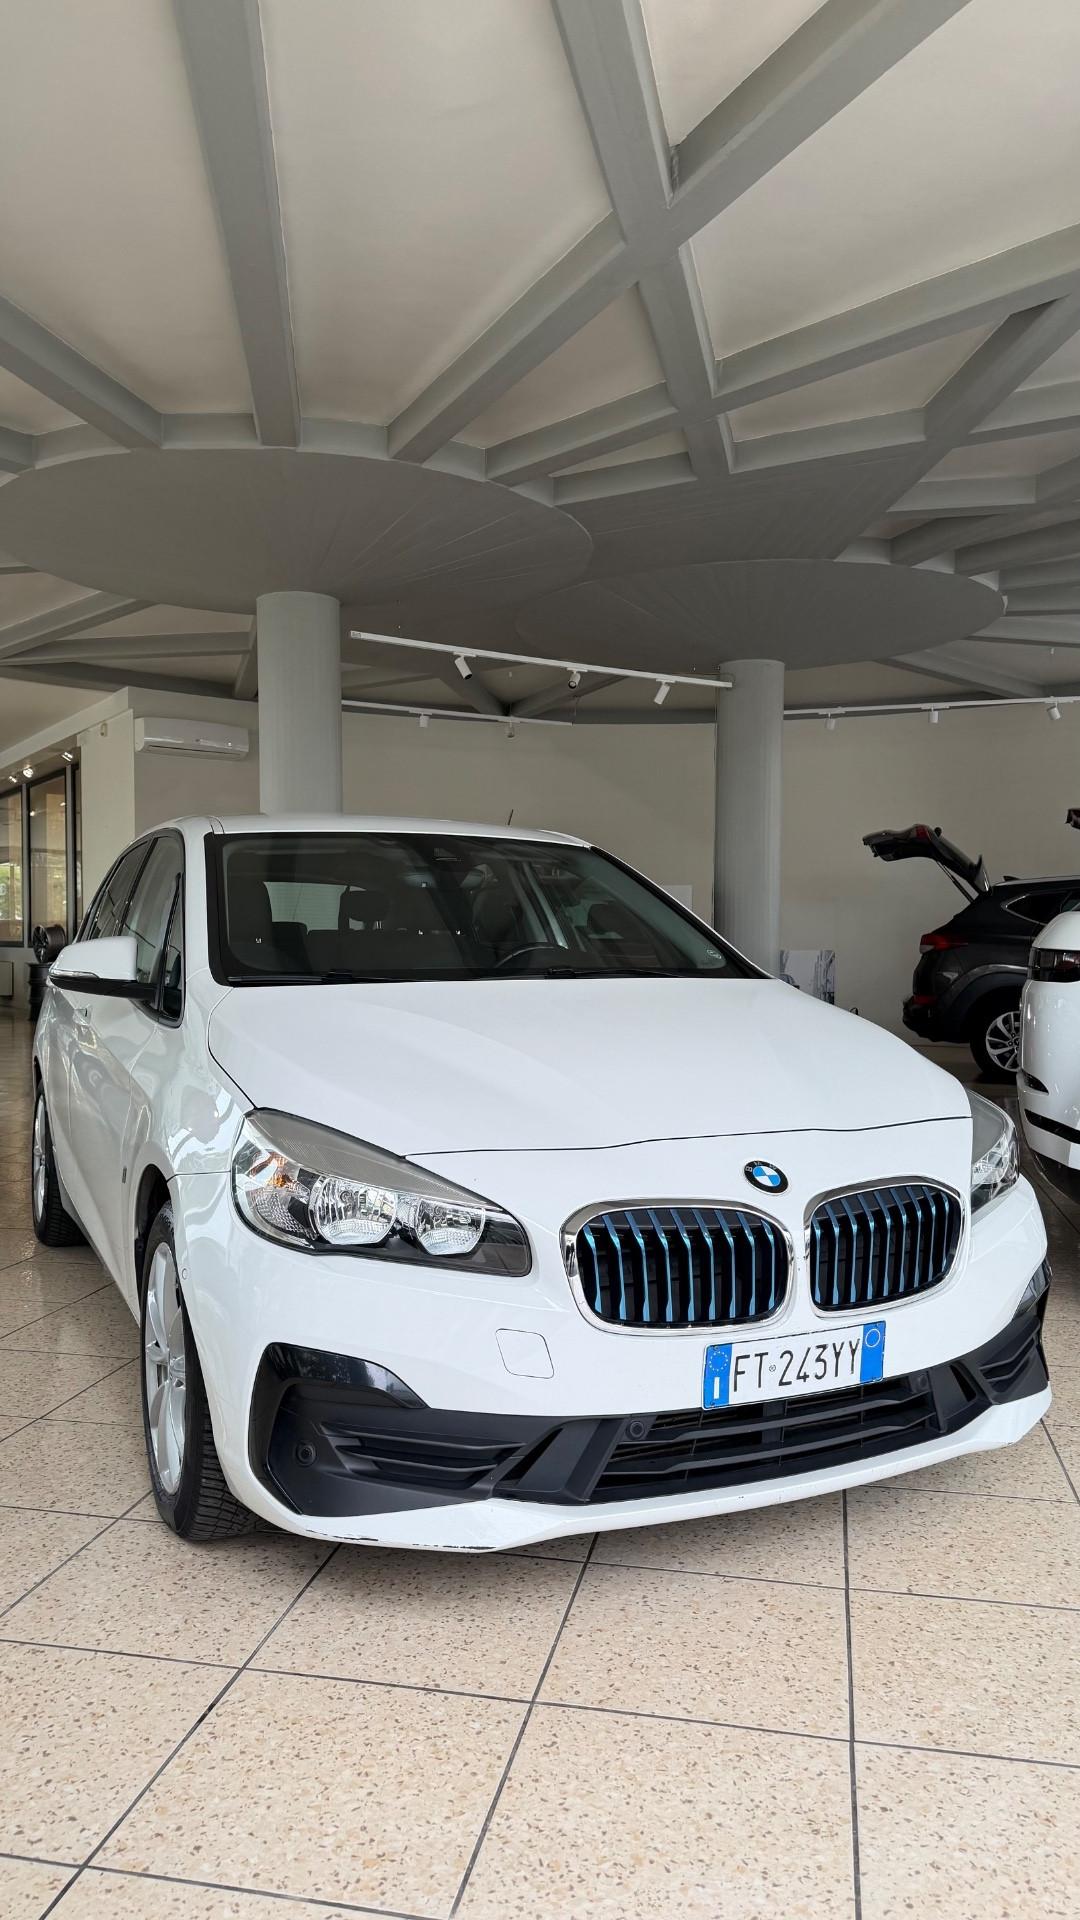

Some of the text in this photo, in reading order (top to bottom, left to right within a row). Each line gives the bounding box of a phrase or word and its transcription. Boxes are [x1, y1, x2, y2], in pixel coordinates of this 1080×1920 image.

[733, 1338, 861, 1392] FT 243YY
[713, 1376, 721, 1400] I
